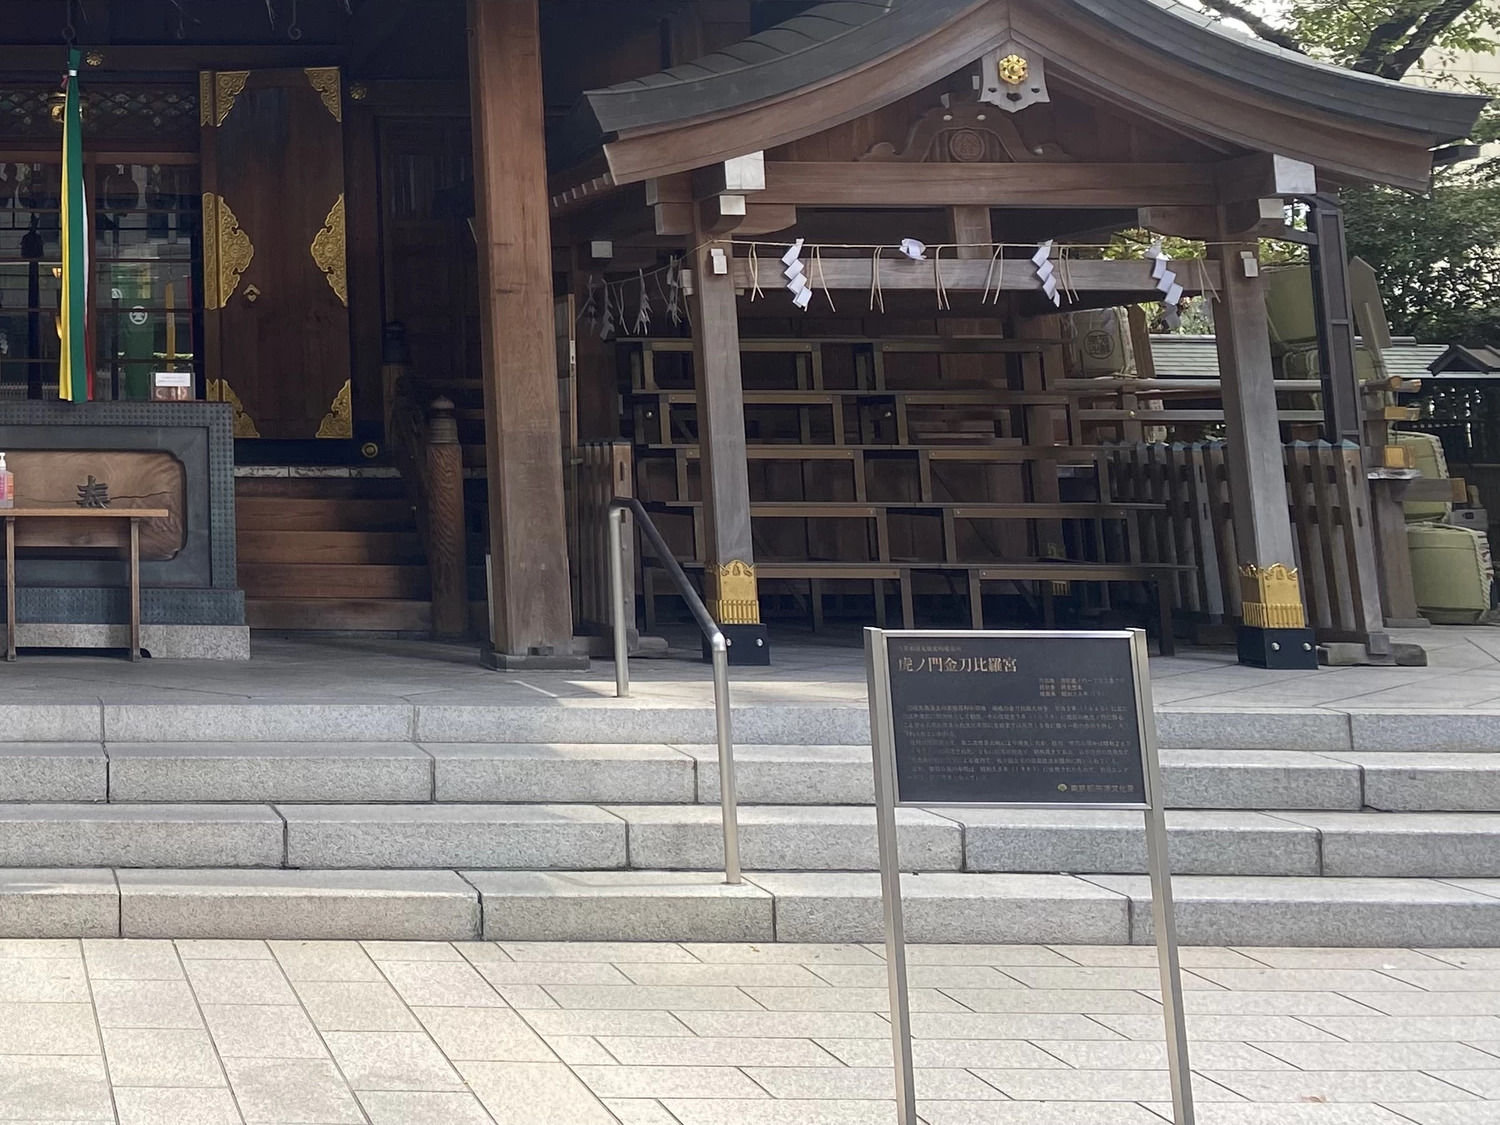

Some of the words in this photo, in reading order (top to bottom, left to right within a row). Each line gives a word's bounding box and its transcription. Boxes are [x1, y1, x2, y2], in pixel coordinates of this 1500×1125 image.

[898, 656, 1018, 673] 虎ノ門金刀比羅宮
